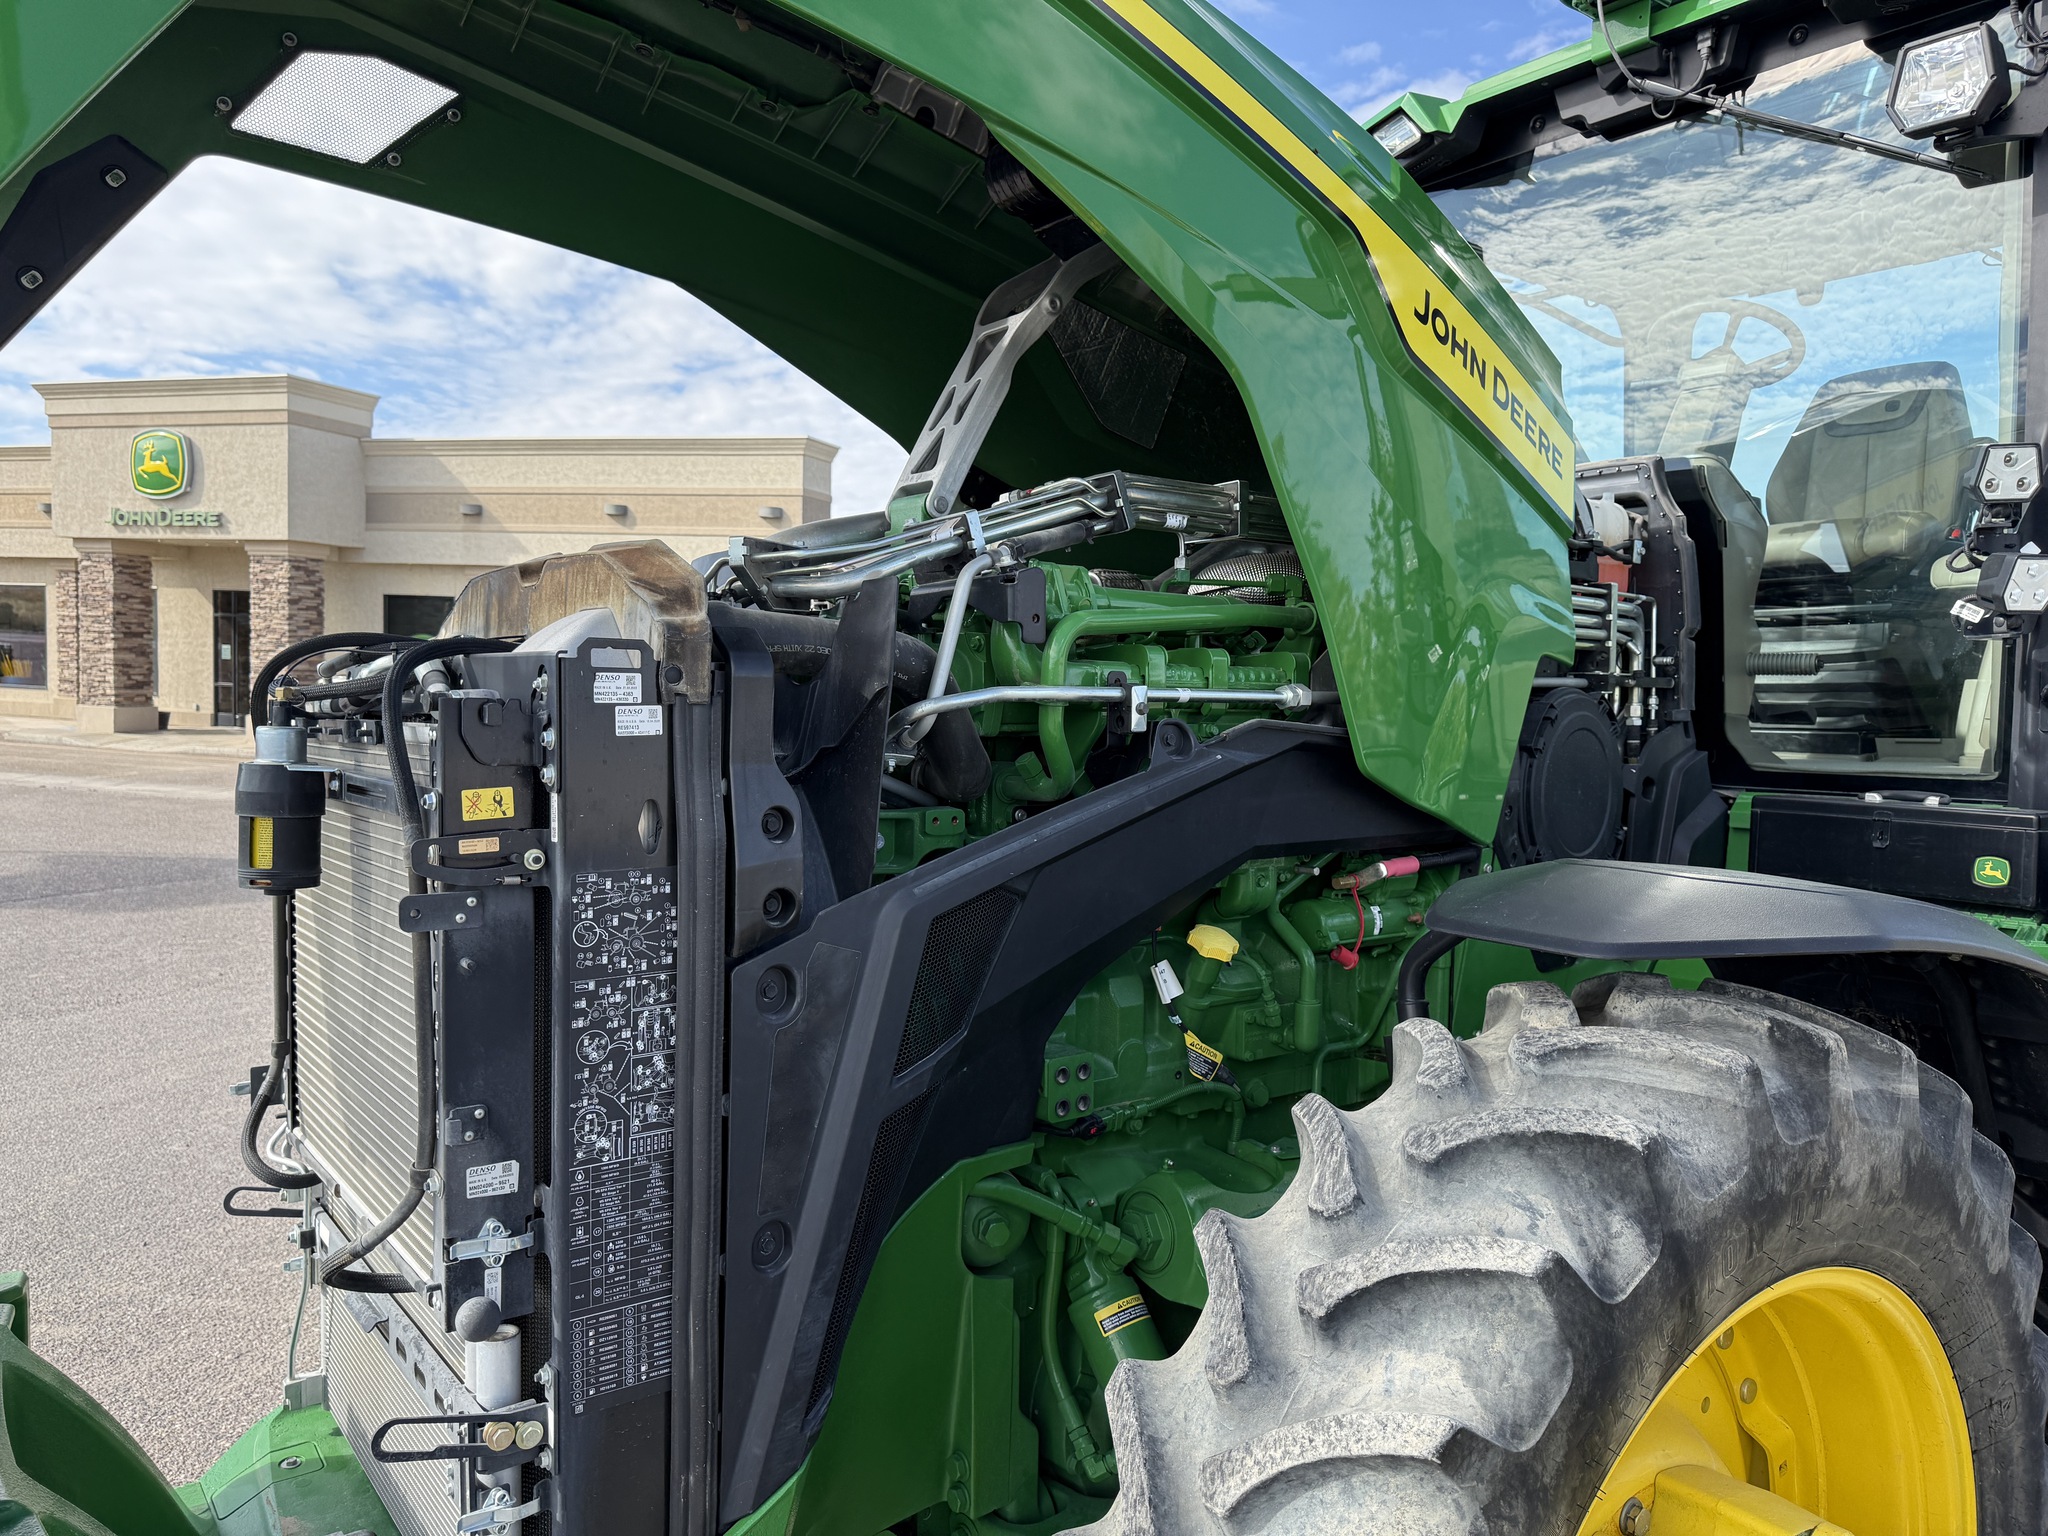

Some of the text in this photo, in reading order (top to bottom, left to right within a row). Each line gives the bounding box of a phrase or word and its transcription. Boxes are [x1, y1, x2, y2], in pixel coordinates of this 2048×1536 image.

[1414, 289, 1563, 480] JOHN DEERE
[104, 507, 220, 526] JOHN DEERE
[816, 646, 832, 655] DEC
[1194, 1042, 1218, 1060] CAUTION
[469, 1164, 496, 1176] DENSO
